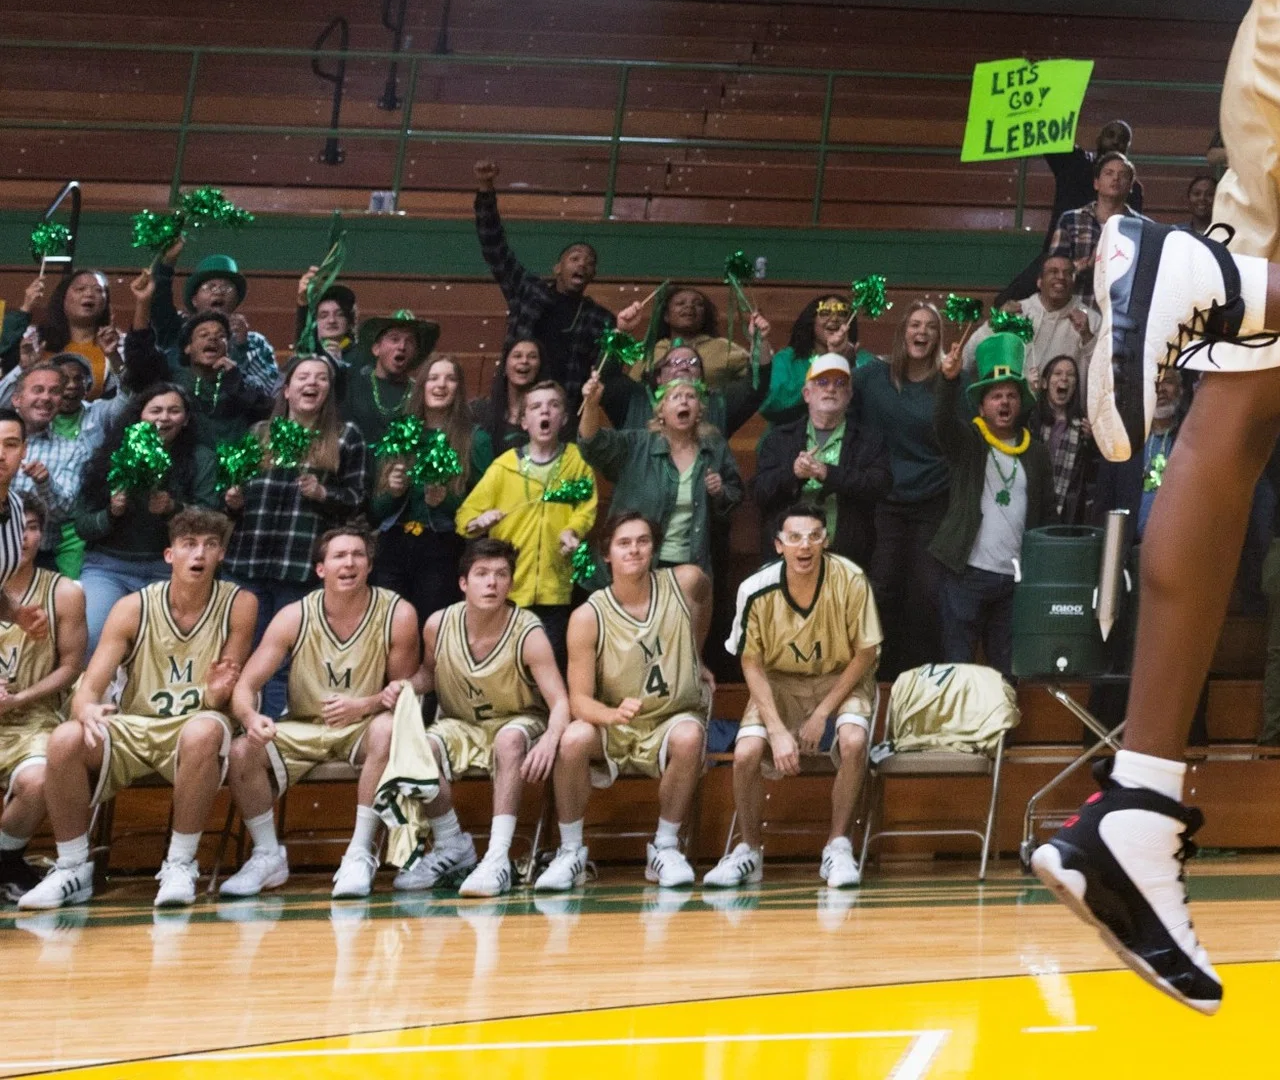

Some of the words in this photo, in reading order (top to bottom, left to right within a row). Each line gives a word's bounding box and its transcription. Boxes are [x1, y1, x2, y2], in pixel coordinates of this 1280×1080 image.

[991, 65, 1039, 95] LETS
[983, 111, 1075, 154] LEBRON
[637, 635, 663, 664] M
[788, 640, 823, 664] M
[168, 655, 194, 684] M
[326, 662, 352, 689] M
[645, 664, 670, 698] 4
